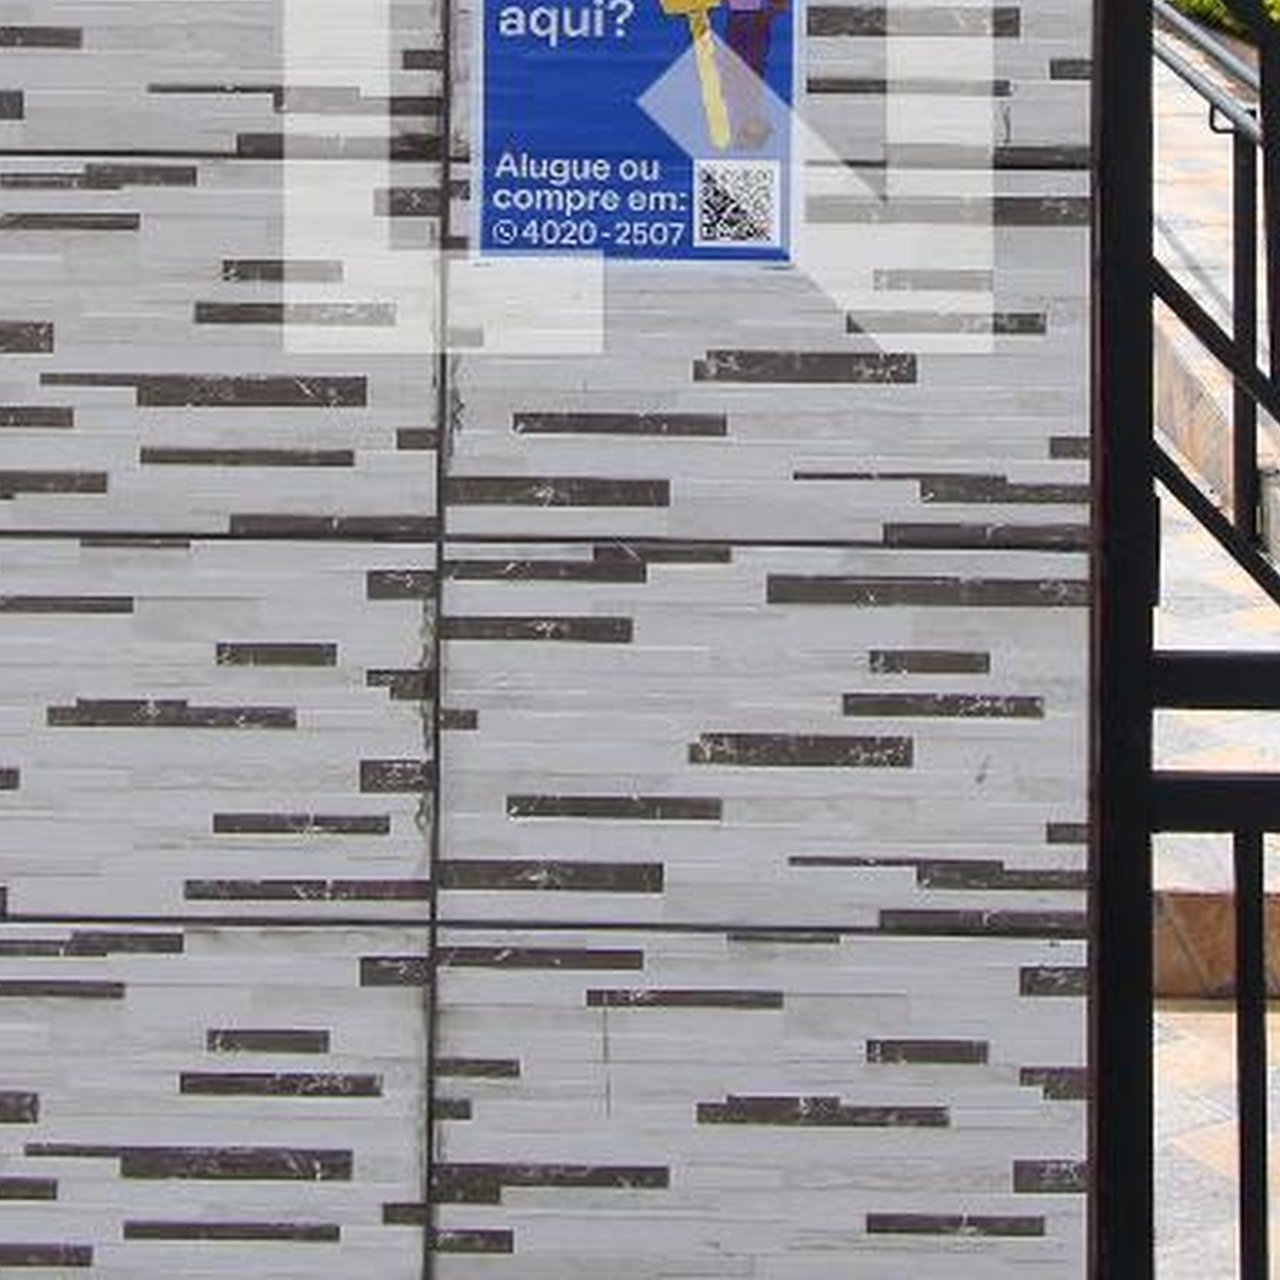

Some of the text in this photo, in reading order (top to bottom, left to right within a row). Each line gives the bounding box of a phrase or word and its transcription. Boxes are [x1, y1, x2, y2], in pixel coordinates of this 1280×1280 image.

[493, 153, 659, 186] Alugue ou
[492, 189, 687, 216] compre em:
